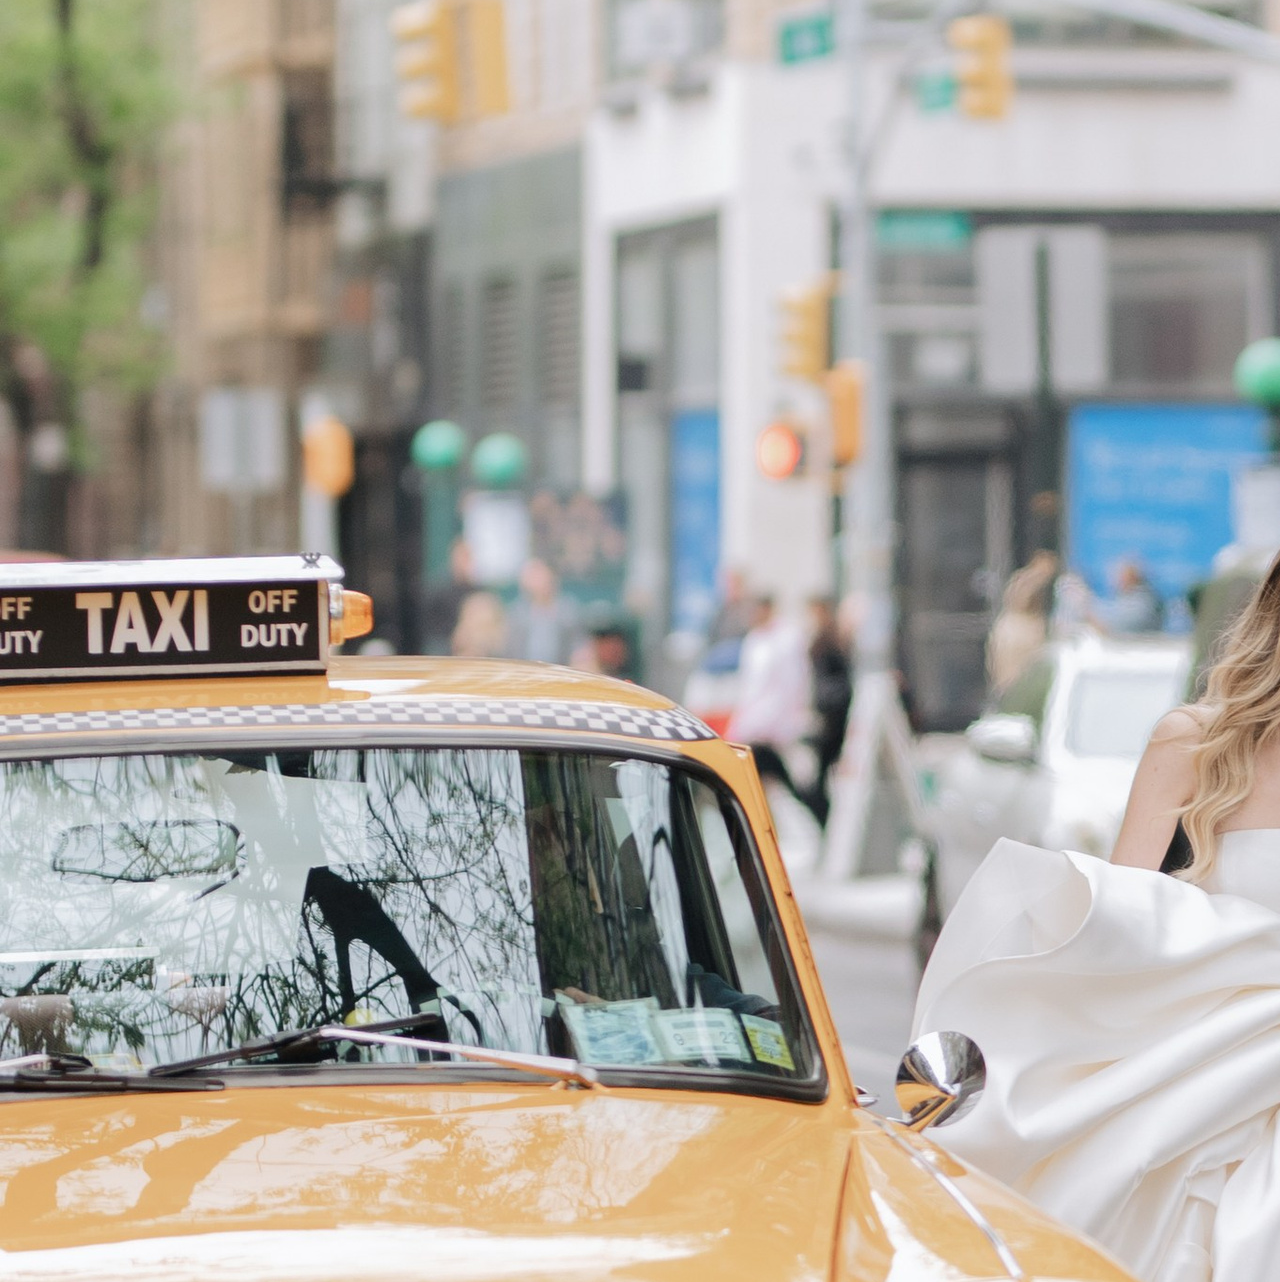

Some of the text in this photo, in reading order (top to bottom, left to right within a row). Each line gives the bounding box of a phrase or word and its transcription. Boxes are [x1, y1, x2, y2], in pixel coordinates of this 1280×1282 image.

[0, 596, 33, 621] FF
[248, 589, 299, 614] OFF
[75, 589, 210, 655] TAXI
[240, 622, 309, 648] DUTY
[0, 629, 43, 655] UTY
